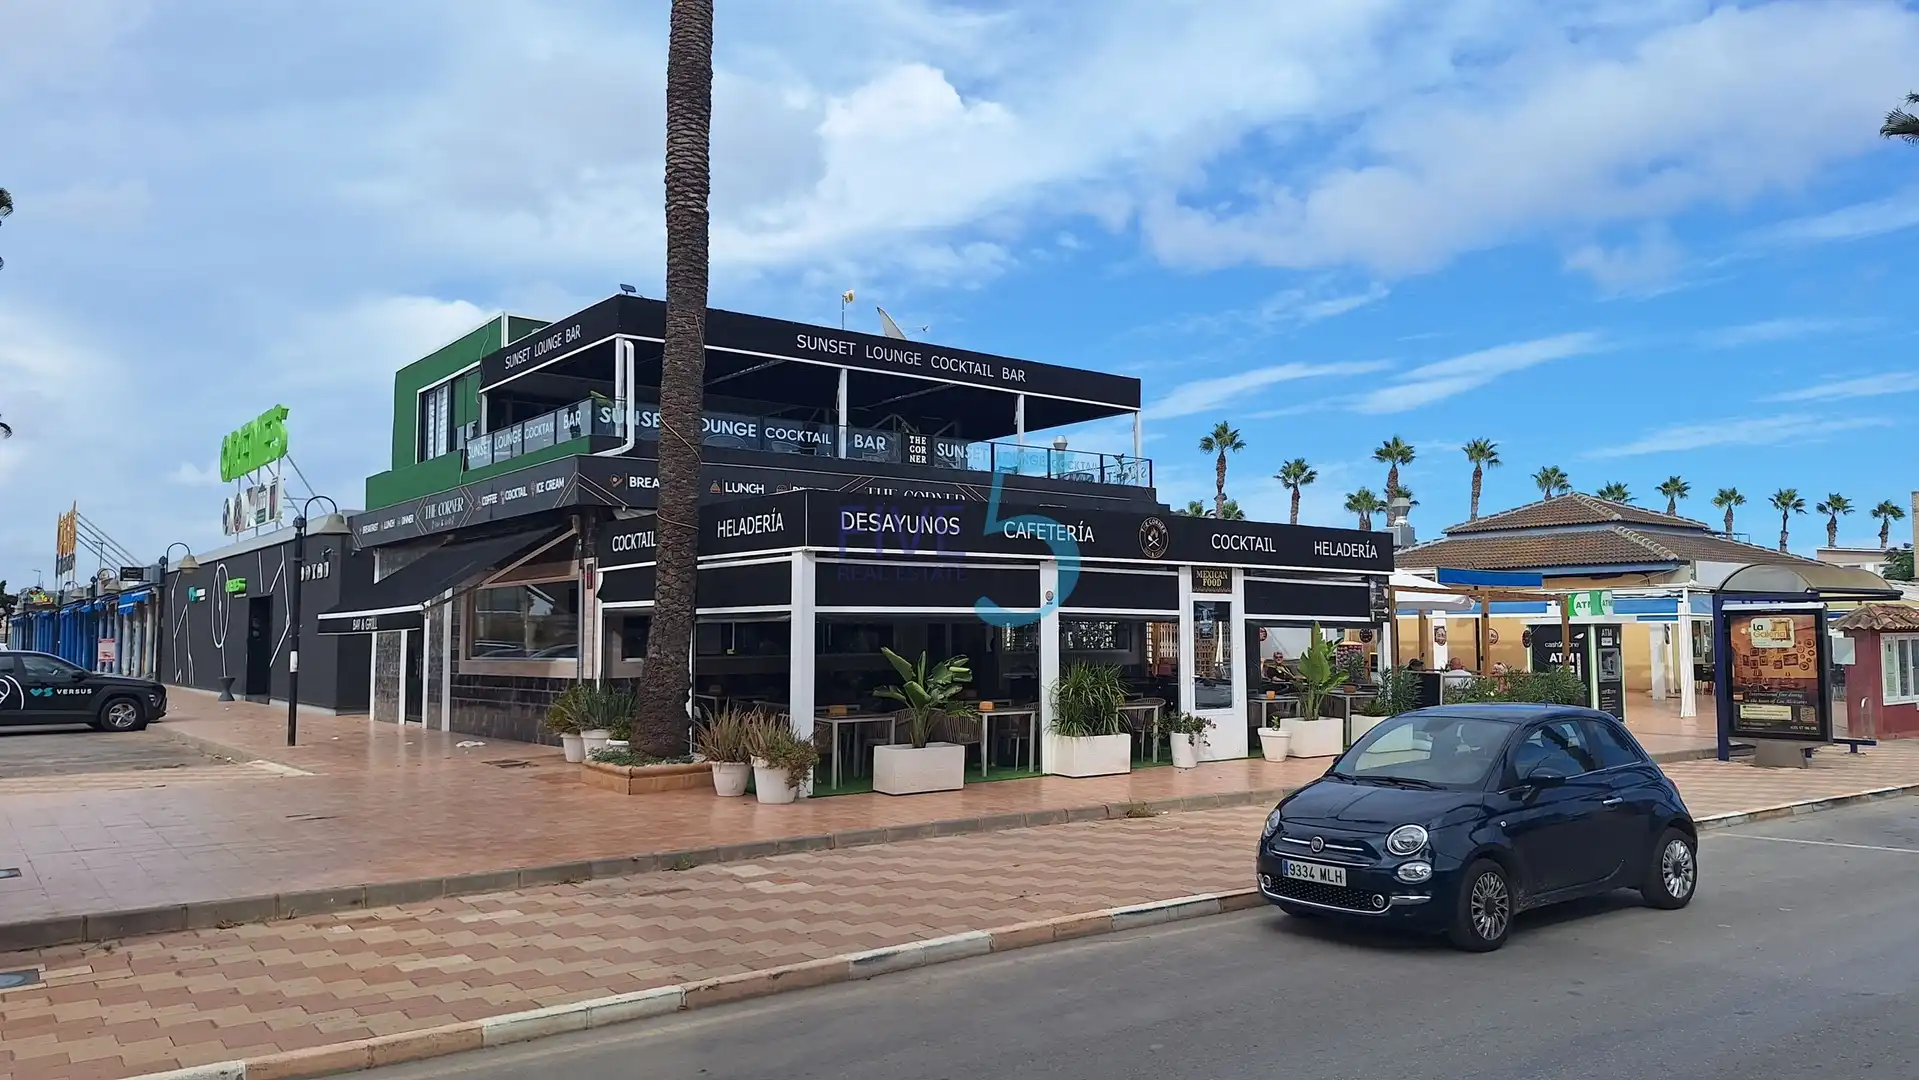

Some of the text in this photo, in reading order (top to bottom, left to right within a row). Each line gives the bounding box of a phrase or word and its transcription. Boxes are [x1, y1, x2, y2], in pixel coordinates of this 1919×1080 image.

[505, 324, 581, 370] SUNSET LOUNGE BAR
[796, 334, 1027, 383] SUNSET LOUNGE COCKTAIL BAR
[467, 409, 581, 460] SUNSET LOUNGE COCKTAIL BAR
[701, 417, 757, 438] OUNGE
[765, 427, 832, 446] COCKTAIL
[854, 433, 886, 451] BAR
[909, 435, 927, 445] THE
[909, 445, 927, 454] COR
[909, 454, 927, 464] NER
[536, 477, 565, 494] ICE CREAM
[725, 482, 765, 495] LUNCH
[424, 497, 465, 520] THE CORNER
[481, 493, 499, 506] COFFEE
[612, 507, 784, 552] COCKTAIL HELADERÍA
[841, 511, 1095, 544] DESAYUNOS CAFETERÍA
[1211, 533, 1378, 559] COCKTAIL HELADERÍA
[1196, 570, 1228, 580] MEXICAN
[1202, 578, 1222, 587] FOOD
[1753, 623, 1763, 631] La
[1289, 863, 1343, 884] 9334 MLH
